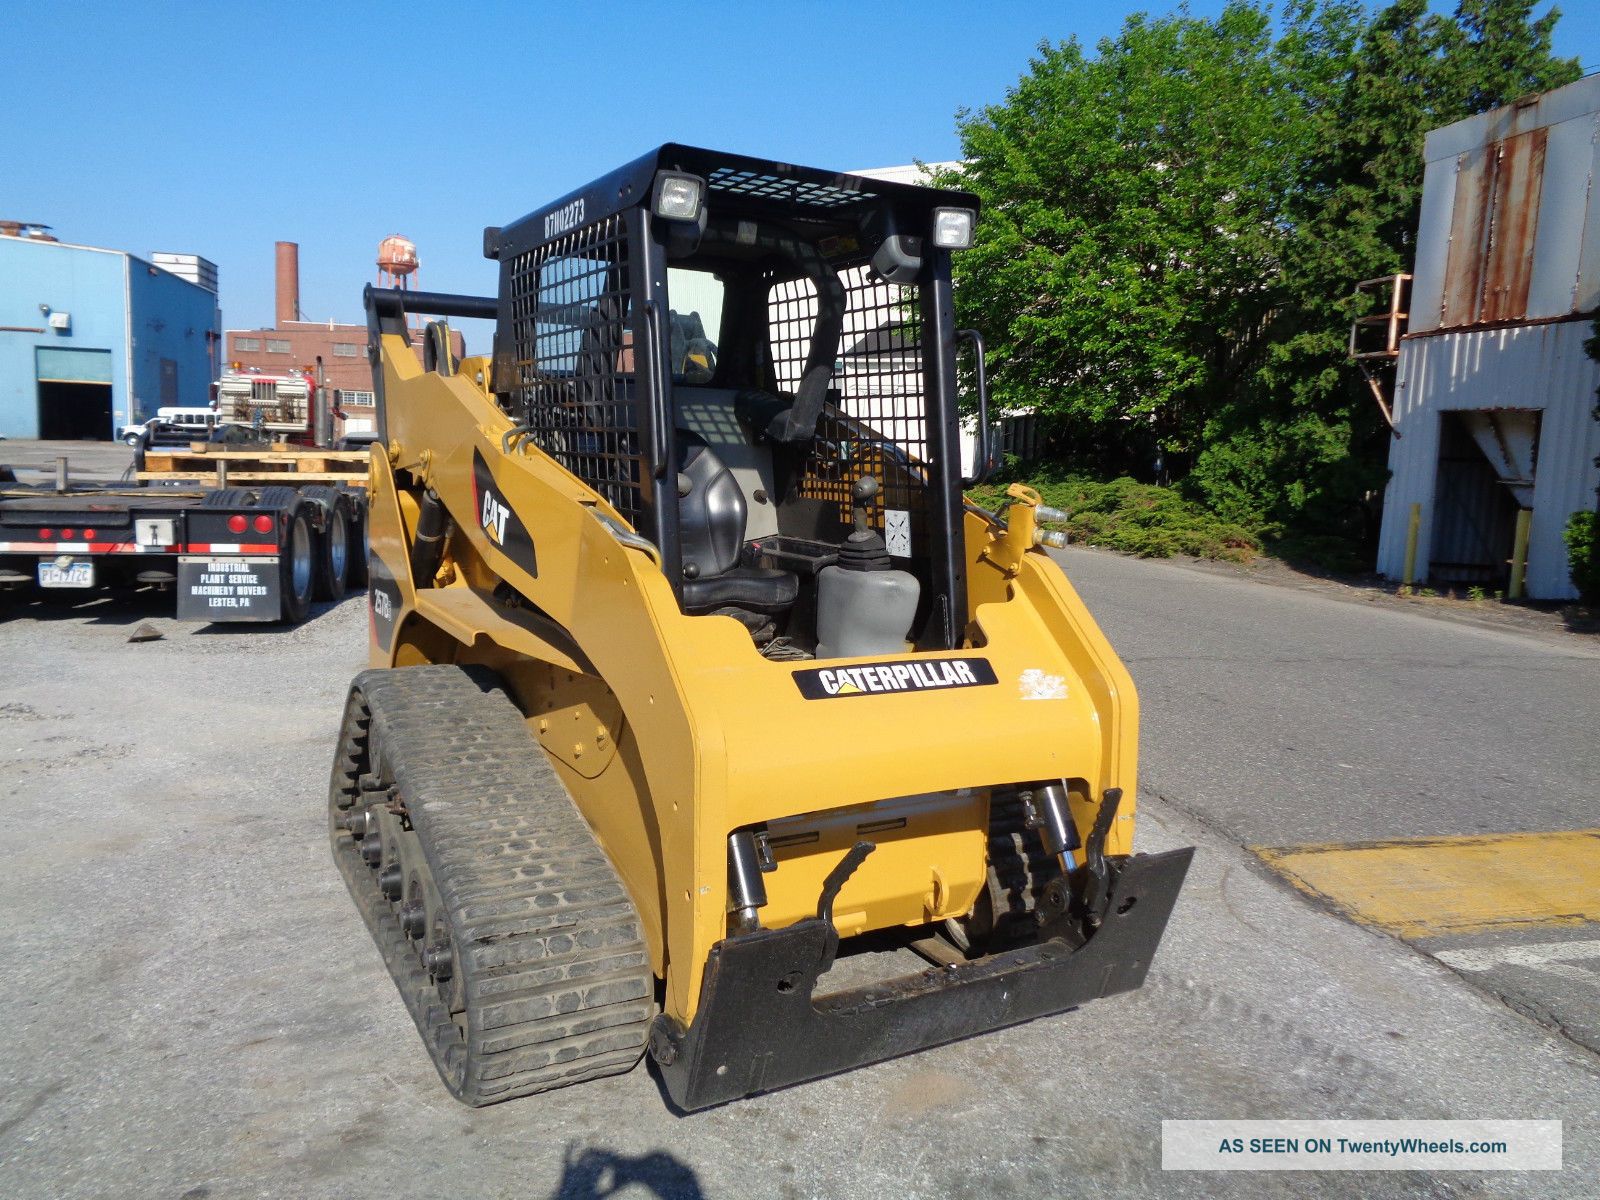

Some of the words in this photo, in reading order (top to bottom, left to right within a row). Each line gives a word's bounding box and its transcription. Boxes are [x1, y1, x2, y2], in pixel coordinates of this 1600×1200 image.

[482, 490, 510, 546] CAT
[207, 562, 250, 573] INDUSTRIAL
[200, 574, 225, 584] PLANT
[228, 574, 258, 584] SERVICE
[191, 585, 234, 595] MACHINERY
[236, 585, 267, 595] MOVERS
[239, 597, 250, 607] PA
[818, 660, 977, 695] CATERPILLAR
